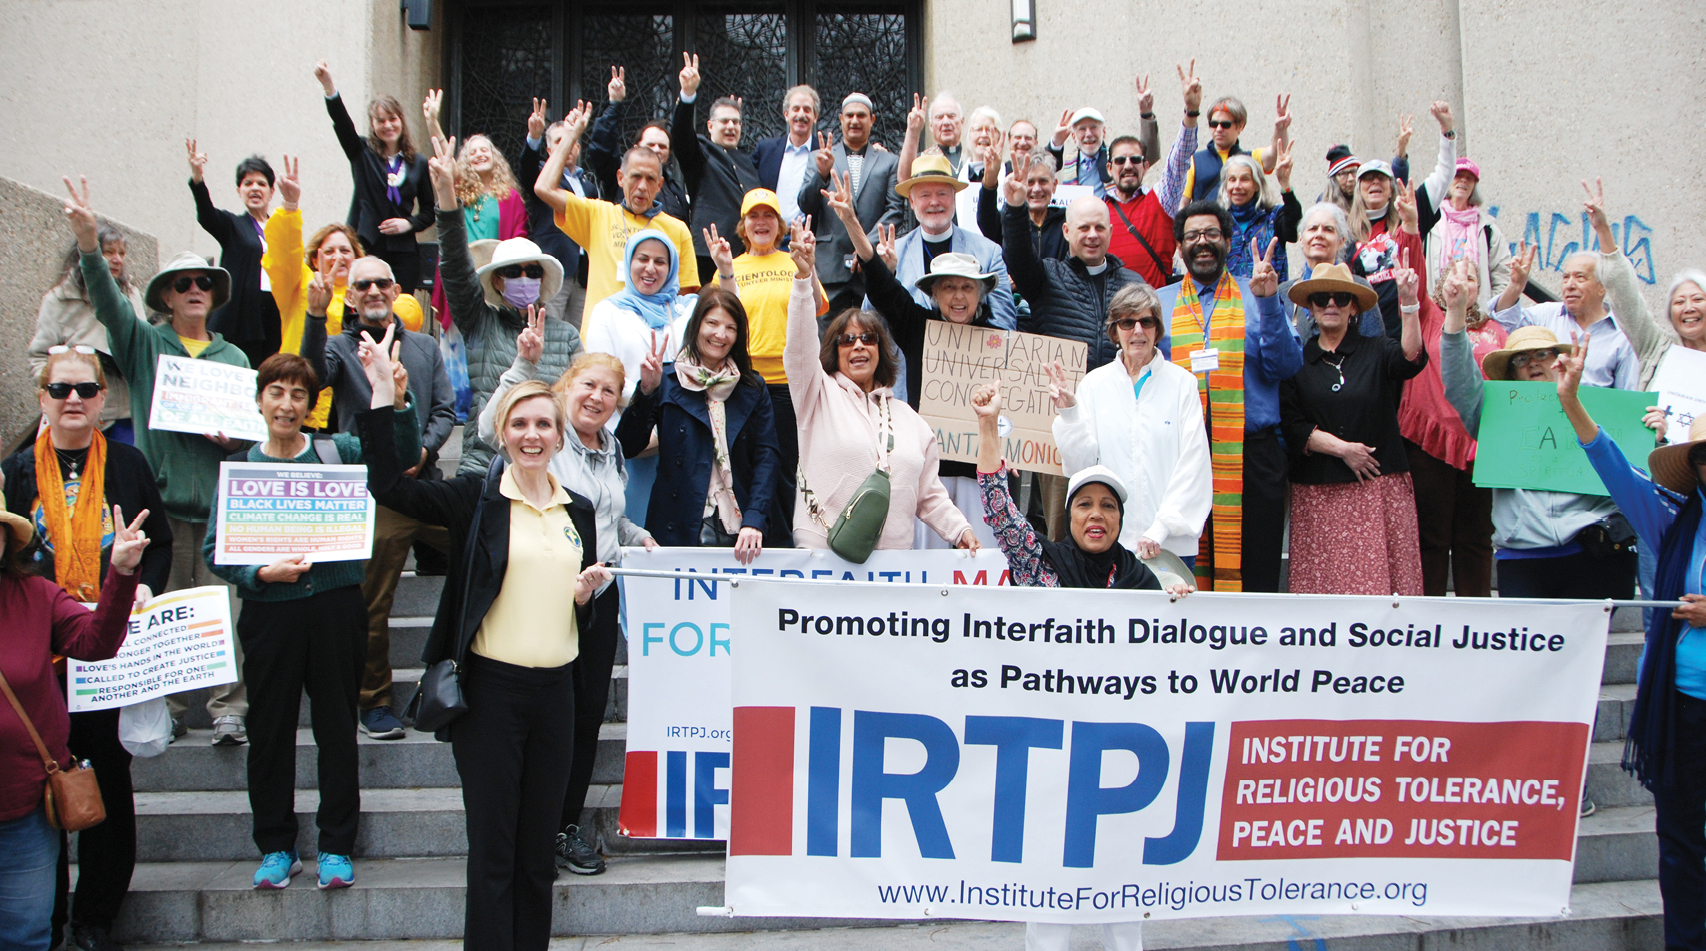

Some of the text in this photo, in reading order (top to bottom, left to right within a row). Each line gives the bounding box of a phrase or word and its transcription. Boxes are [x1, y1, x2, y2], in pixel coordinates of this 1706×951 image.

[735, 270, 794, 282] CIENTOLOG
[162, 373, 257, 398] NEIGHBO
[166, 360, 195, 374] WE
[200, 364, 244, 382] LOVE
[162, 410, 186, 423] OF
[188, 413, 219, 426] ALL
[934, 427, 1063, 467] ANT MONIC
[231, 480, 367, 497] LOVE IS LOVE
[229, 499, 365, 510] BLACK LIVES MATTER
[229, 513, 364, 522] CLIMATE CHANGE IS REAL
[229, 524, 364, 533] NO HUMAN BEING IS ILLEGAL
[337, 534, 363, 542] RIGHTS
[128, 605, 195, 635] E ARE:
[778, 608, 1565, 652] Promoting Interfaith Dialogue and Social Justice
[134, 625, 187, 646] CONNECTED
[153, 633, 201, 650] TOGETHER
[82, 640, 218, 672] LOVE'S HANDS IN THE WORLD
[86, 652, 216, 684] CALLED TO CREATE JUSTICE
[90, 671, 215, 703] ANOTHER AND THE EARTH
[99, 665, 206, 694] RESPONSIBLE FOR ONE
[950, 664, 1405, 700] as Pathways to World Peace
[1241, 735, 1451, 764] INSTITUTE FOR
[807, 705, 1216, 868] IRTPJ
[1236, 777, 1566, 811] RELIGIOUS TOLERANCE,
[1232, 818, 1519, 848] PEACE AND JUSTICE
[877, 877, 1428, 911] www.InstituteForReligiousTolerance.org
